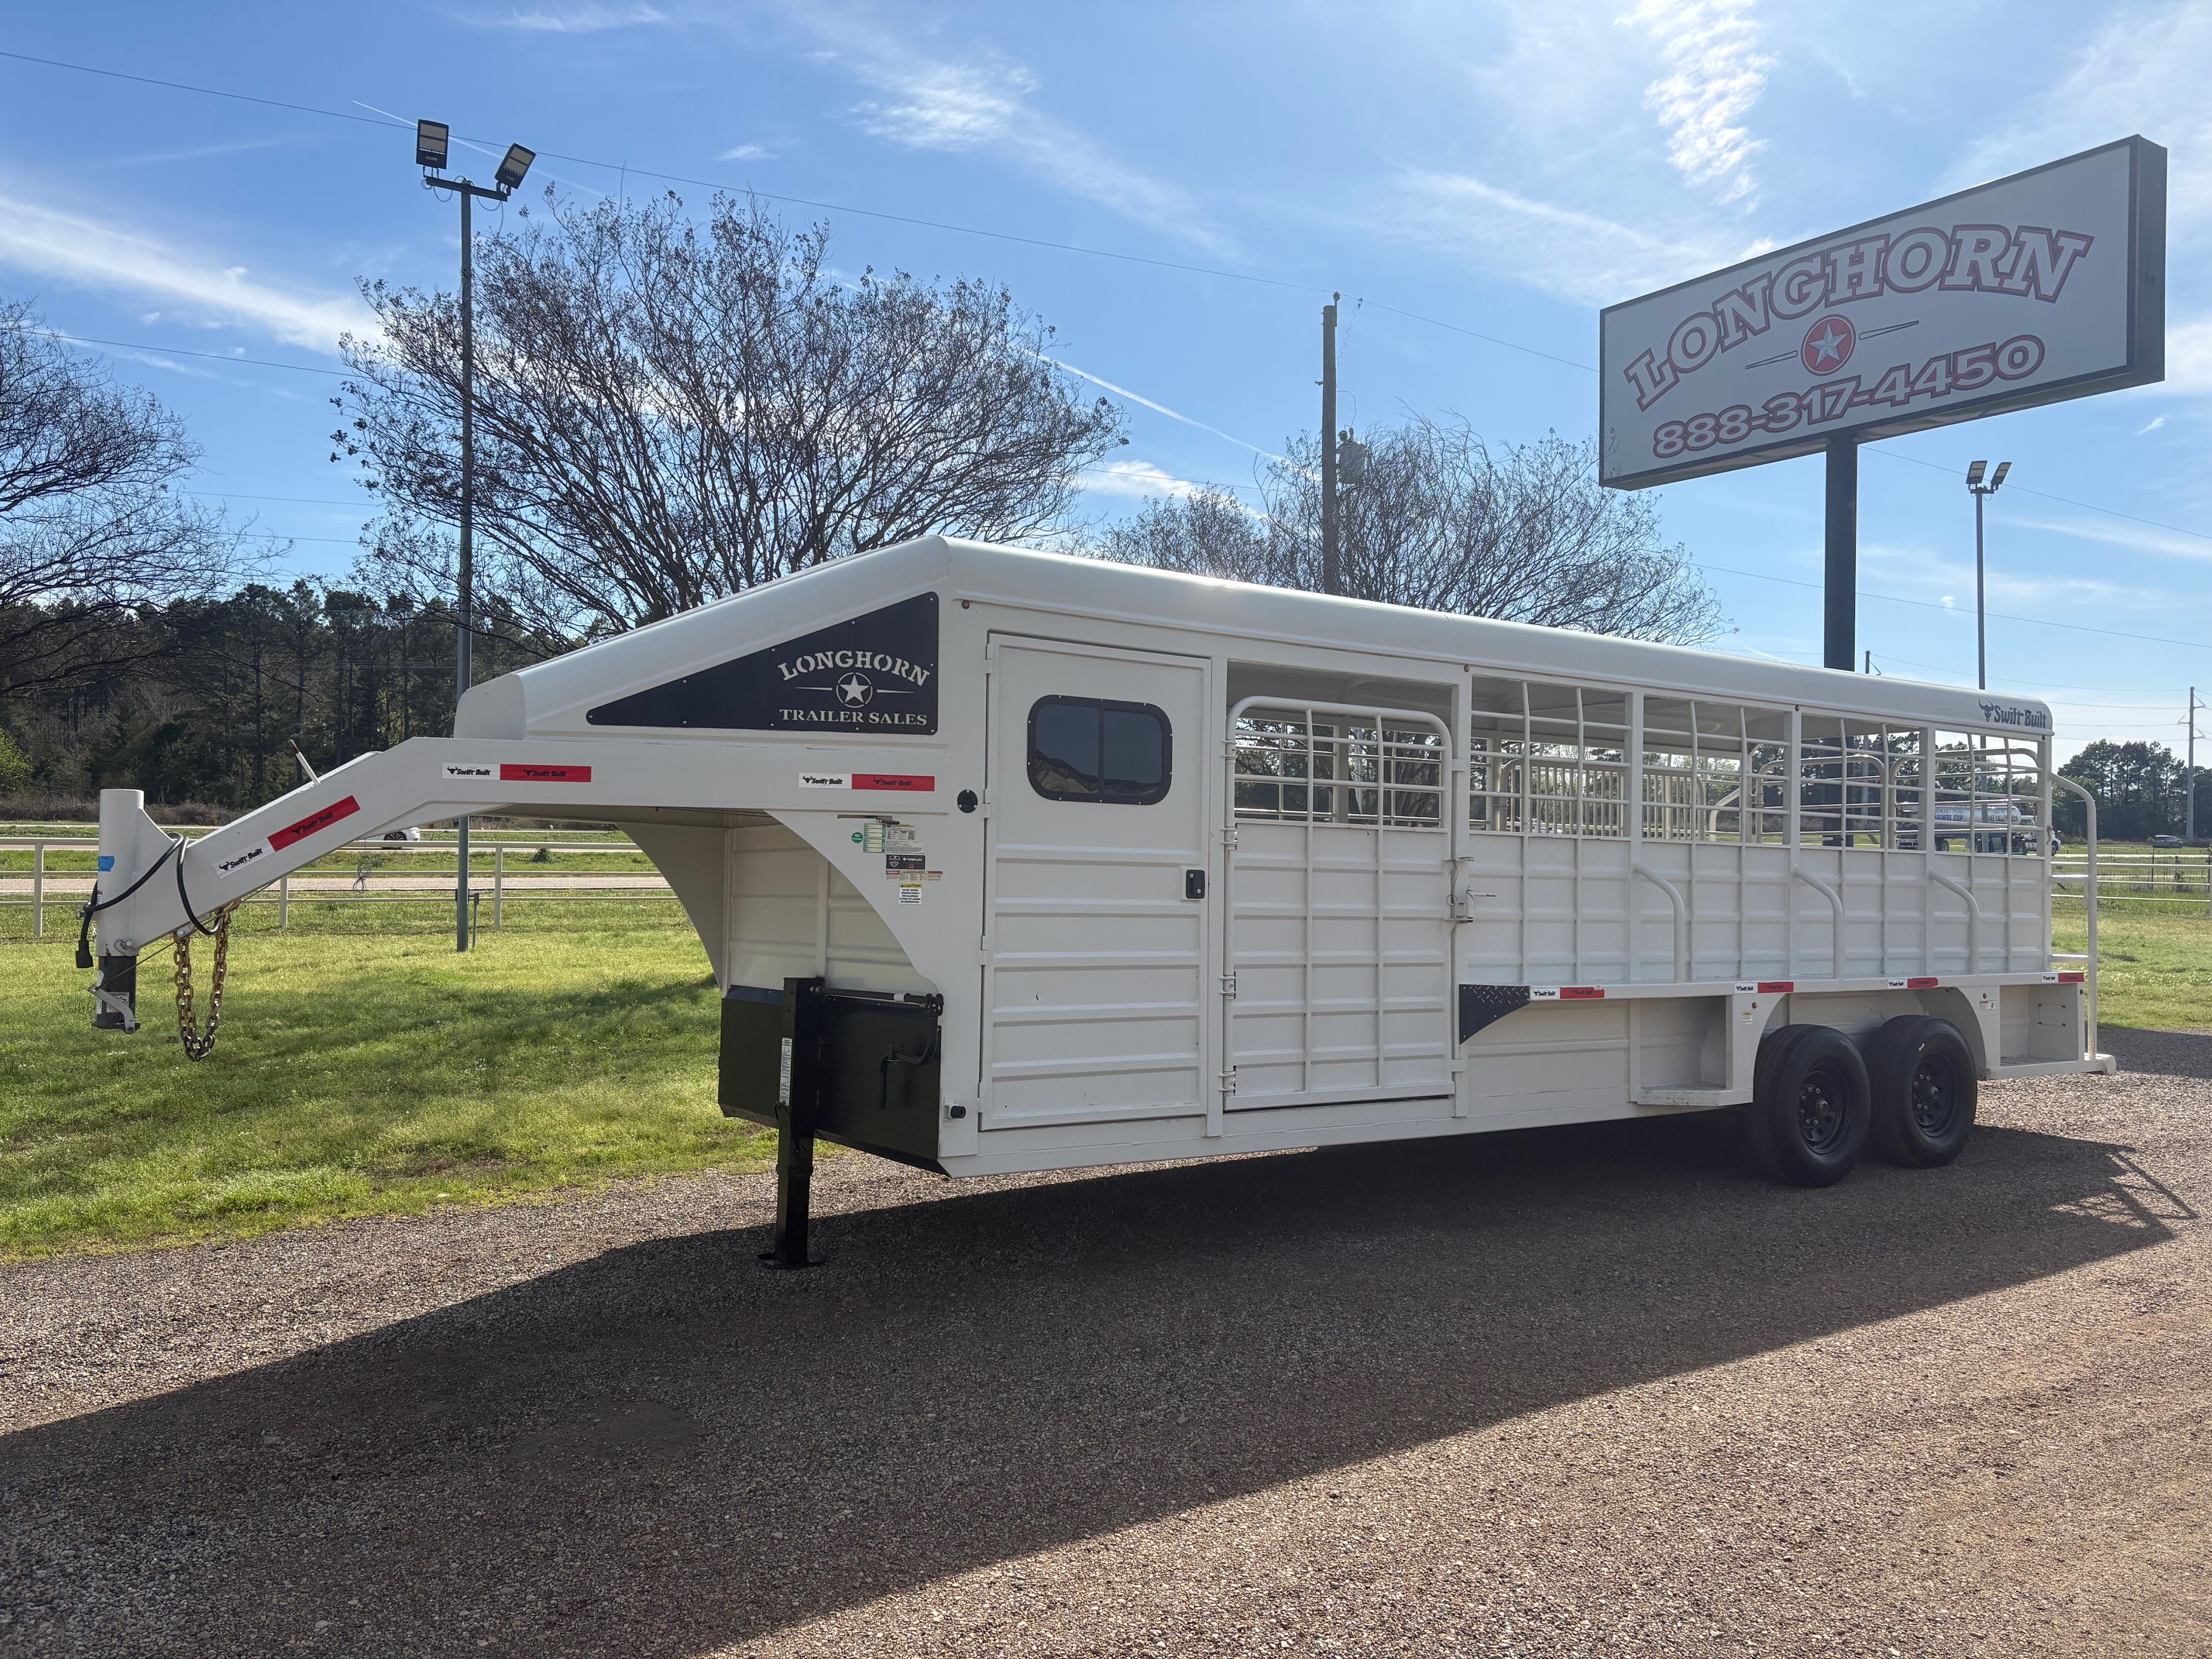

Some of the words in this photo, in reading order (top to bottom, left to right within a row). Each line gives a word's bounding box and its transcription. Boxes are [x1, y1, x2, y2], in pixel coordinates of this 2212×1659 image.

[1624, 224, 2094, 412] LONGHORN
[1653, 334, 2045, 459] 888-317-4450
[778, 650, 930, 686] LONGHORN
[779, 709, 864, 723] TRAILER
[868, 712, 927, 725] SALES
[1994, 705, 2025, 726] Swift
[2024, 709, 2047, 729] Built
[230, 856, 248, 868] Swift
[248, 848, 263, 860] Built
